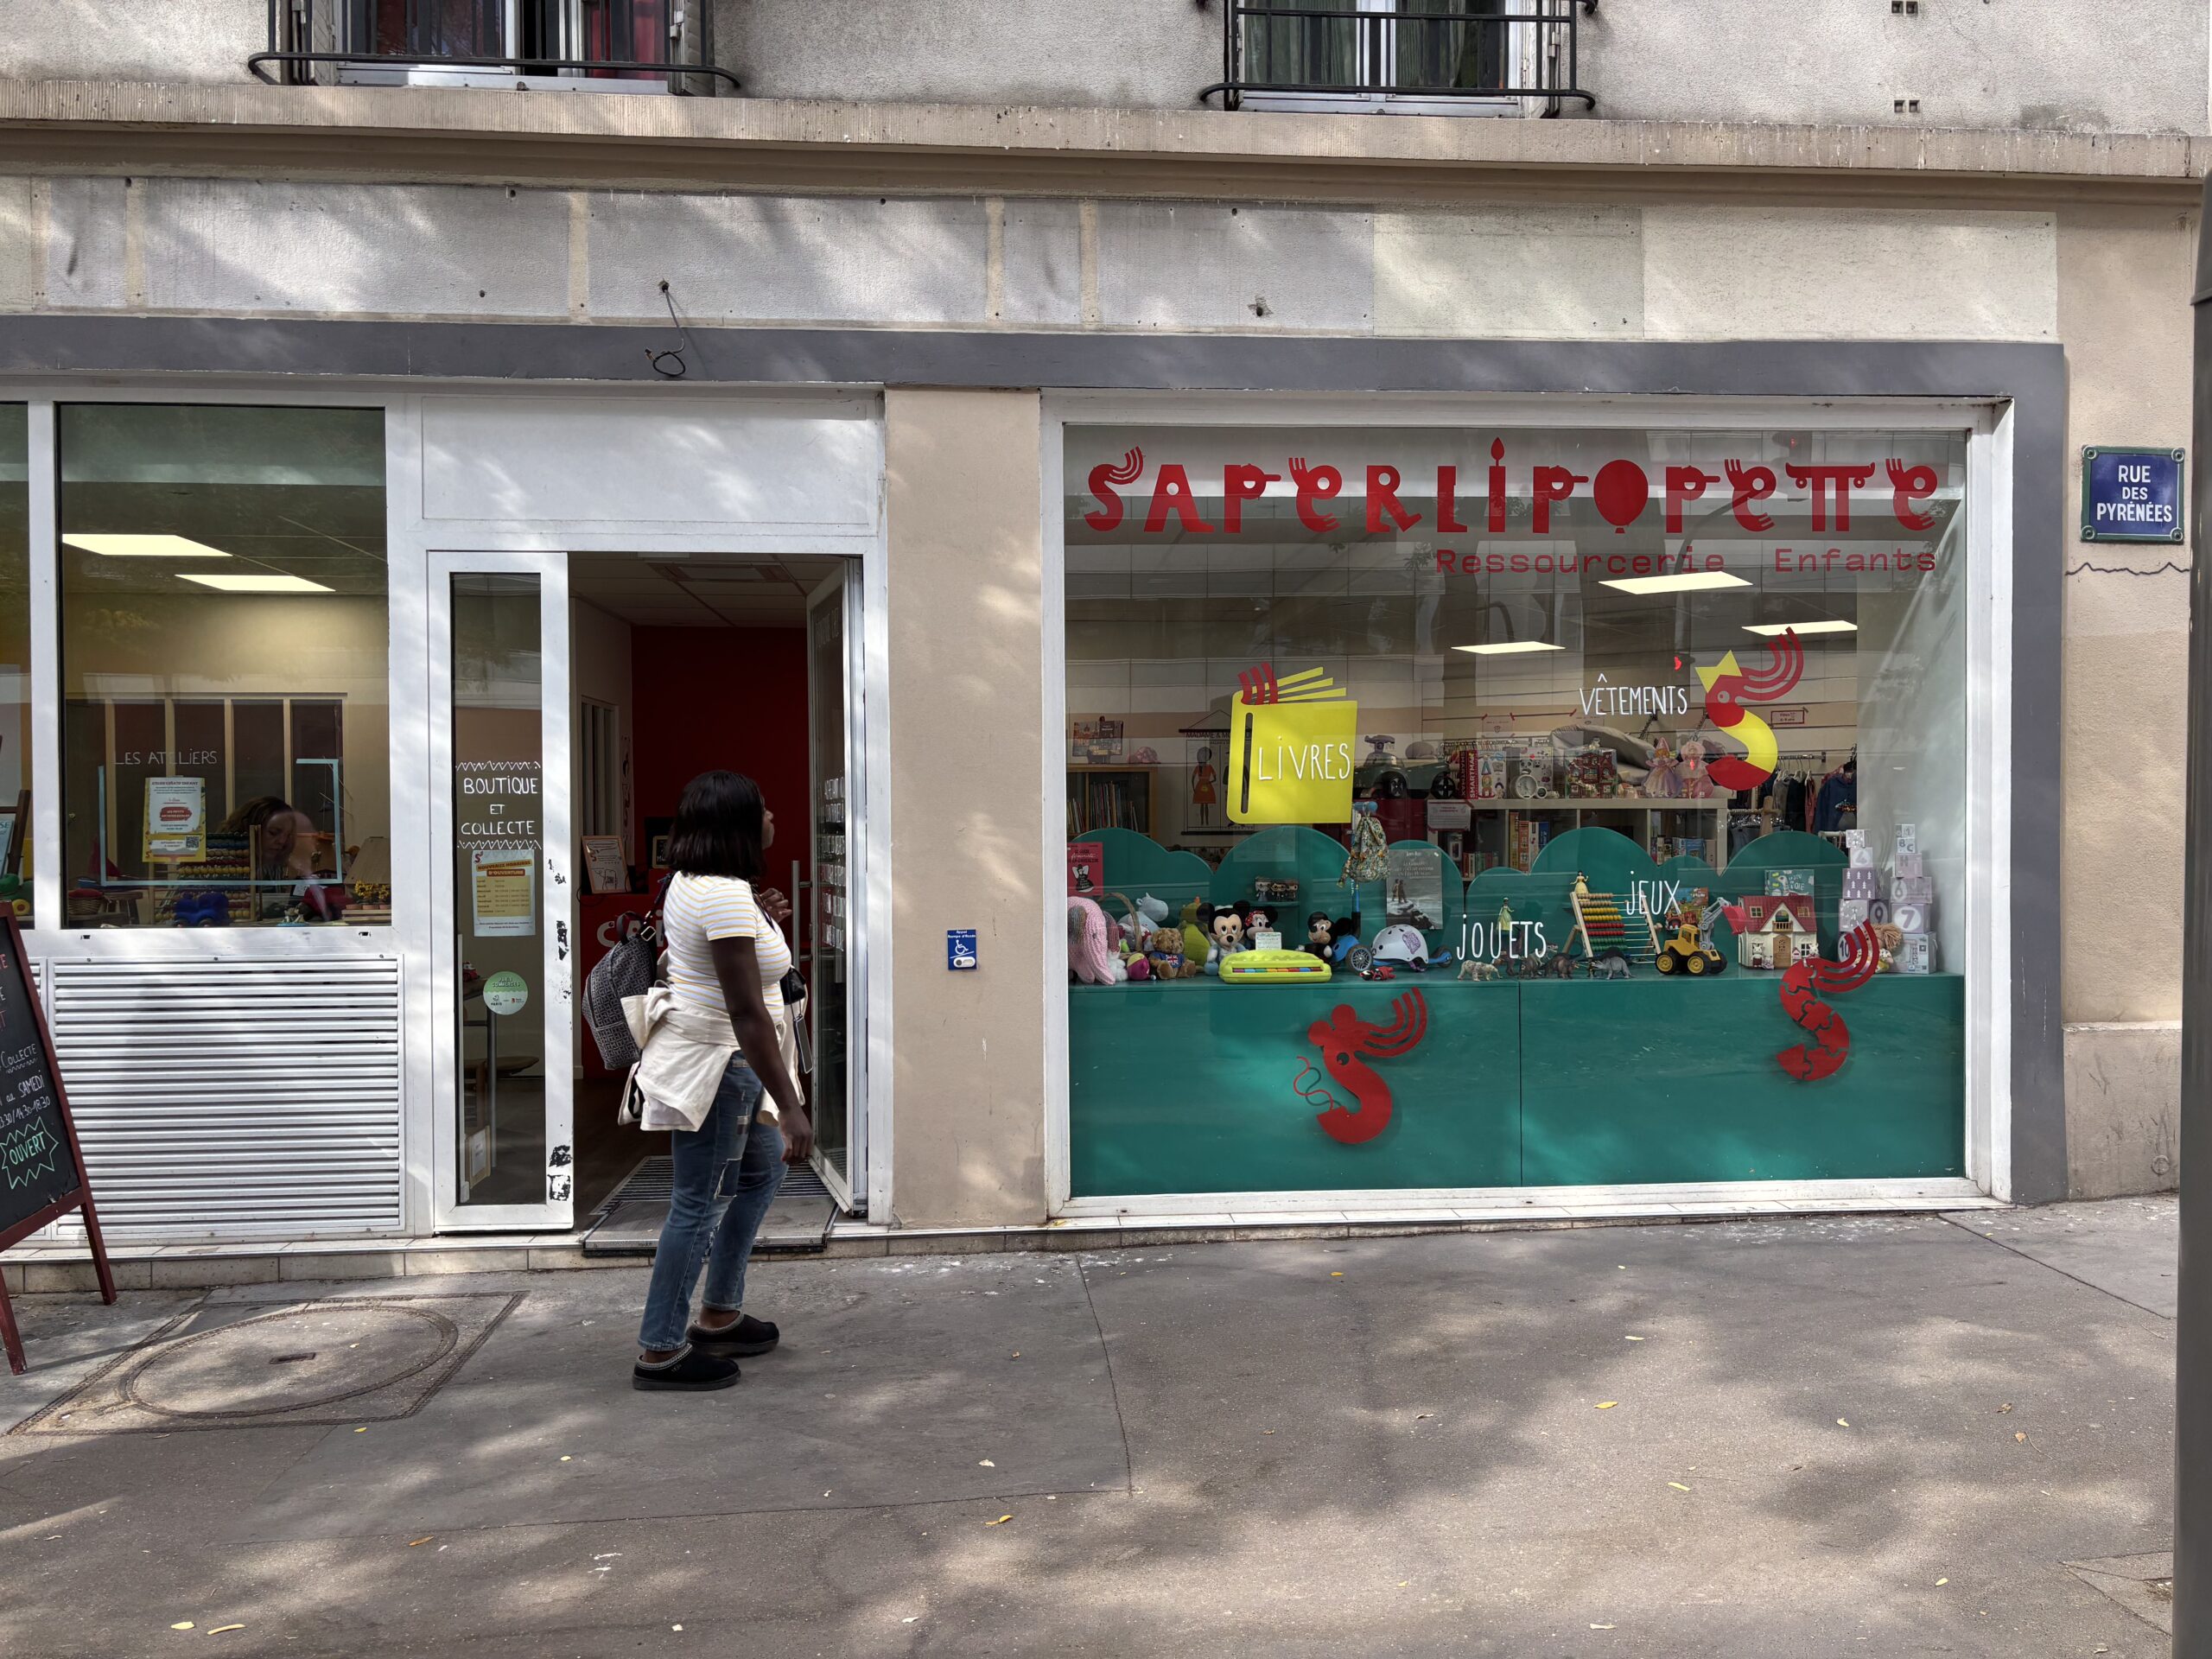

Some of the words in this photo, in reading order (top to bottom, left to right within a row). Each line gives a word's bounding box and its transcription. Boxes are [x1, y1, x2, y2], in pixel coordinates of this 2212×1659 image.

[2118, 465, 2152, 483] RUE
[2121, 486, 2148, 500] DES
[2096, 501, 2173, 523] PYRÉNÉES
[1436, 546, 1726, 574] Ressourcerie
[1773, 547, 1936, 573] Enfants
[1580, 673, 1688, 716] VÊTEMENTS
[112, 750, 141, 766] LES
[463, 775, 538, 795] BOUTIQUE
[490, 804, 505, 815] ET
[461, 820, 536, 836] COLLECTE
[1874, 902, 1884, 919] 9
[1901, 909, 1915, 929] 7
[9, 1131, 47, 1166] OUVERT
